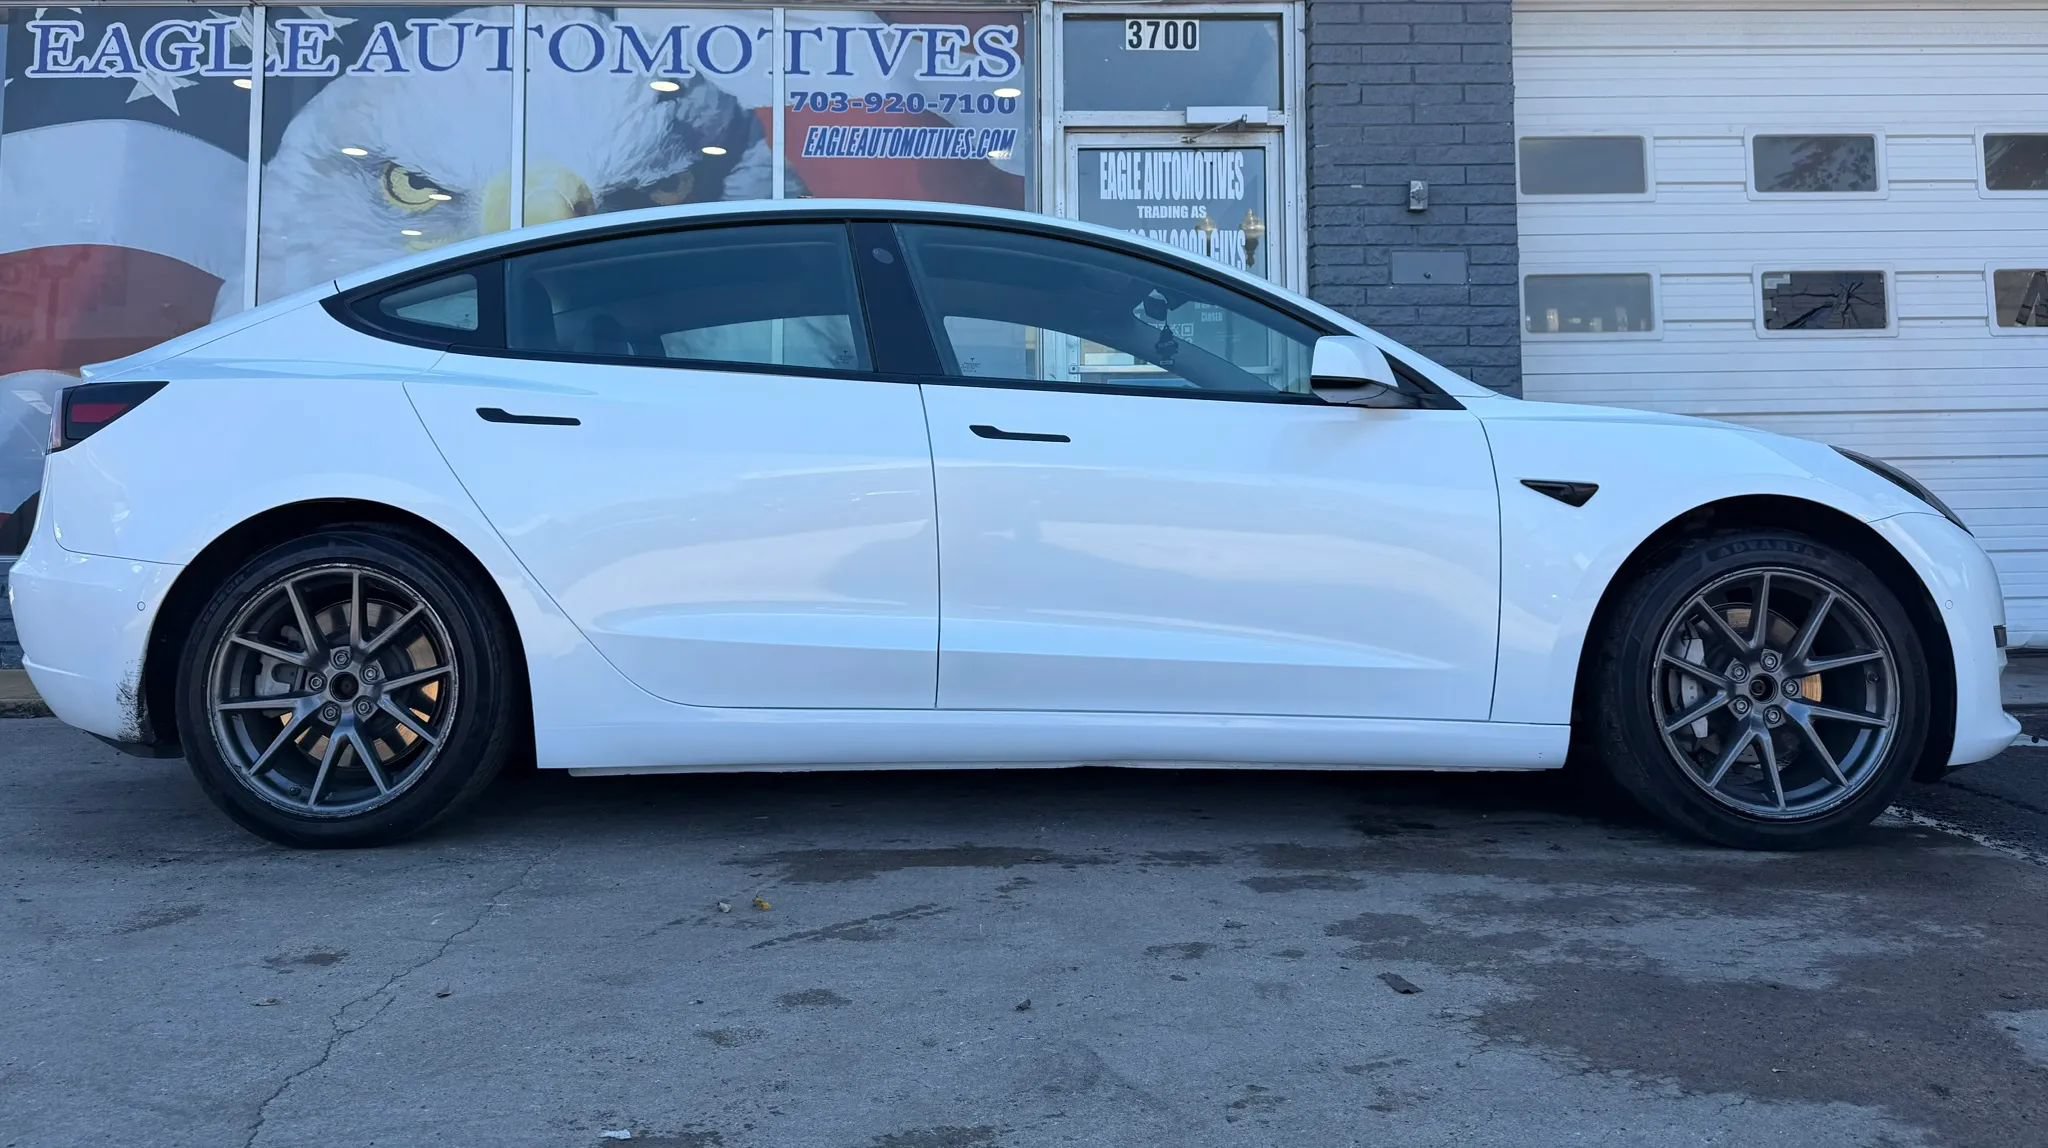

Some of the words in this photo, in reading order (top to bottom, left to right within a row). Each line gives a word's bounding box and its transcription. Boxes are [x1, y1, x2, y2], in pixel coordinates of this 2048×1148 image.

[27, 19, 340, 79] EAGLE
[352, 19, 1022, 81] AUTOMOTIVES
[1127, 20, 1197, 50] 3700
[790, 91, 1017, 115] 703-920-7100
[802, 126, 1017, 159] EAGLEAUTOMOTIVES.COM
[1100, 151, 1142, 200] EAGLE
[1144, 151, 1244, 200] AUTOMOTIVES
[1137, 205, 1188, 219] TRADING
[1190, 205, 1207, 219] AS
